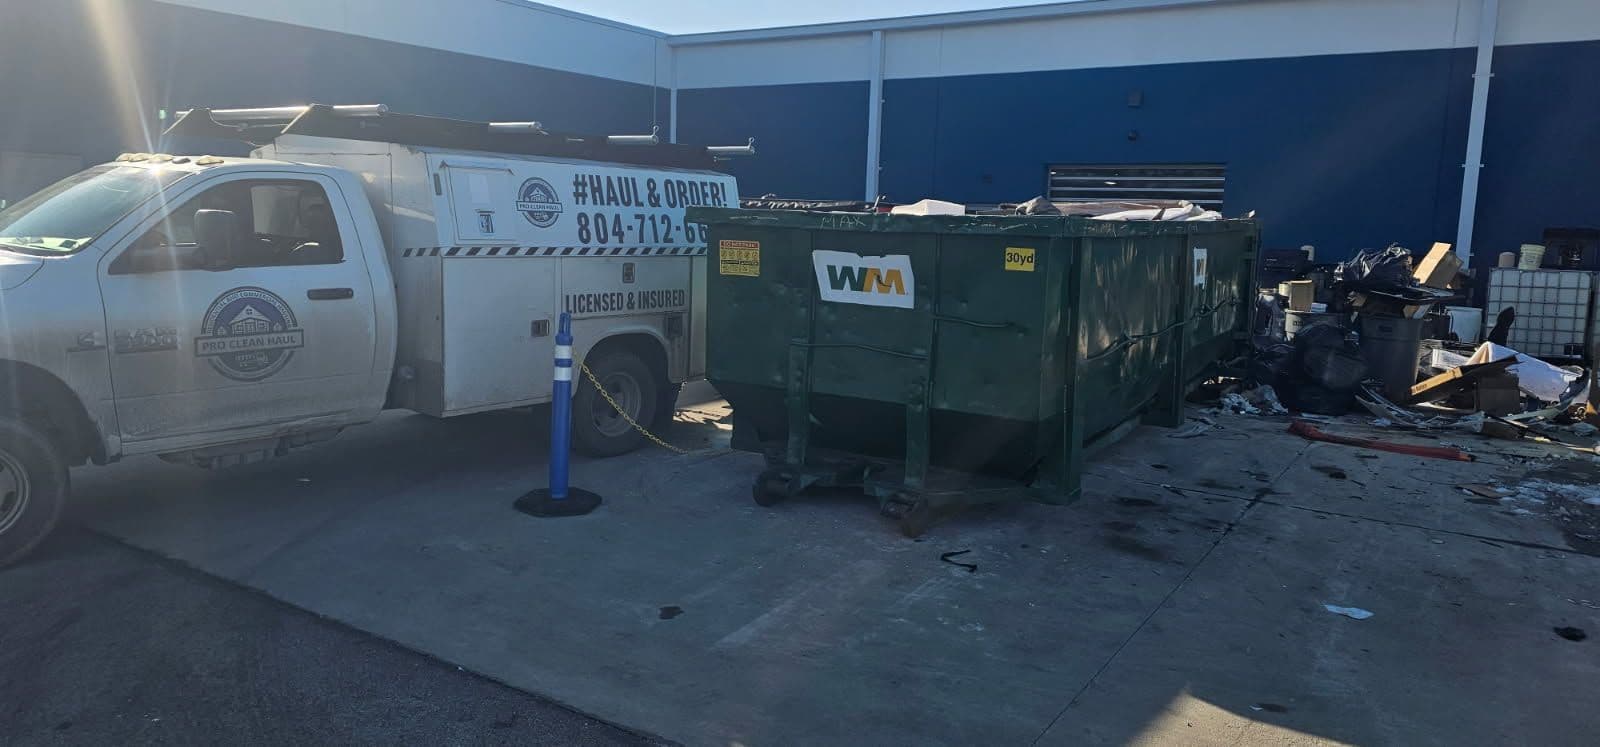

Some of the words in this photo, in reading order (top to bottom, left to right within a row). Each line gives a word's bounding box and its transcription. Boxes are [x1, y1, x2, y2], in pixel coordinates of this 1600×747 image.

[573, 173, 644, 208] #HAUL
[647, 177, 662, 208] &
[664, 178, 727, 208] ORDER!
[1006, 252, 1034, 265] 30yd
[826, 264, 906, 296] WM
[566, 292, 624, 314] LICENSED
[626, 291, 636, 311] &
[638, 289, 685, 309] INSURED
[202, 341, 226, 351] PRO
[229, 337, 264, 349] CLEAN
[267, 335, 296, 345] HAUL
